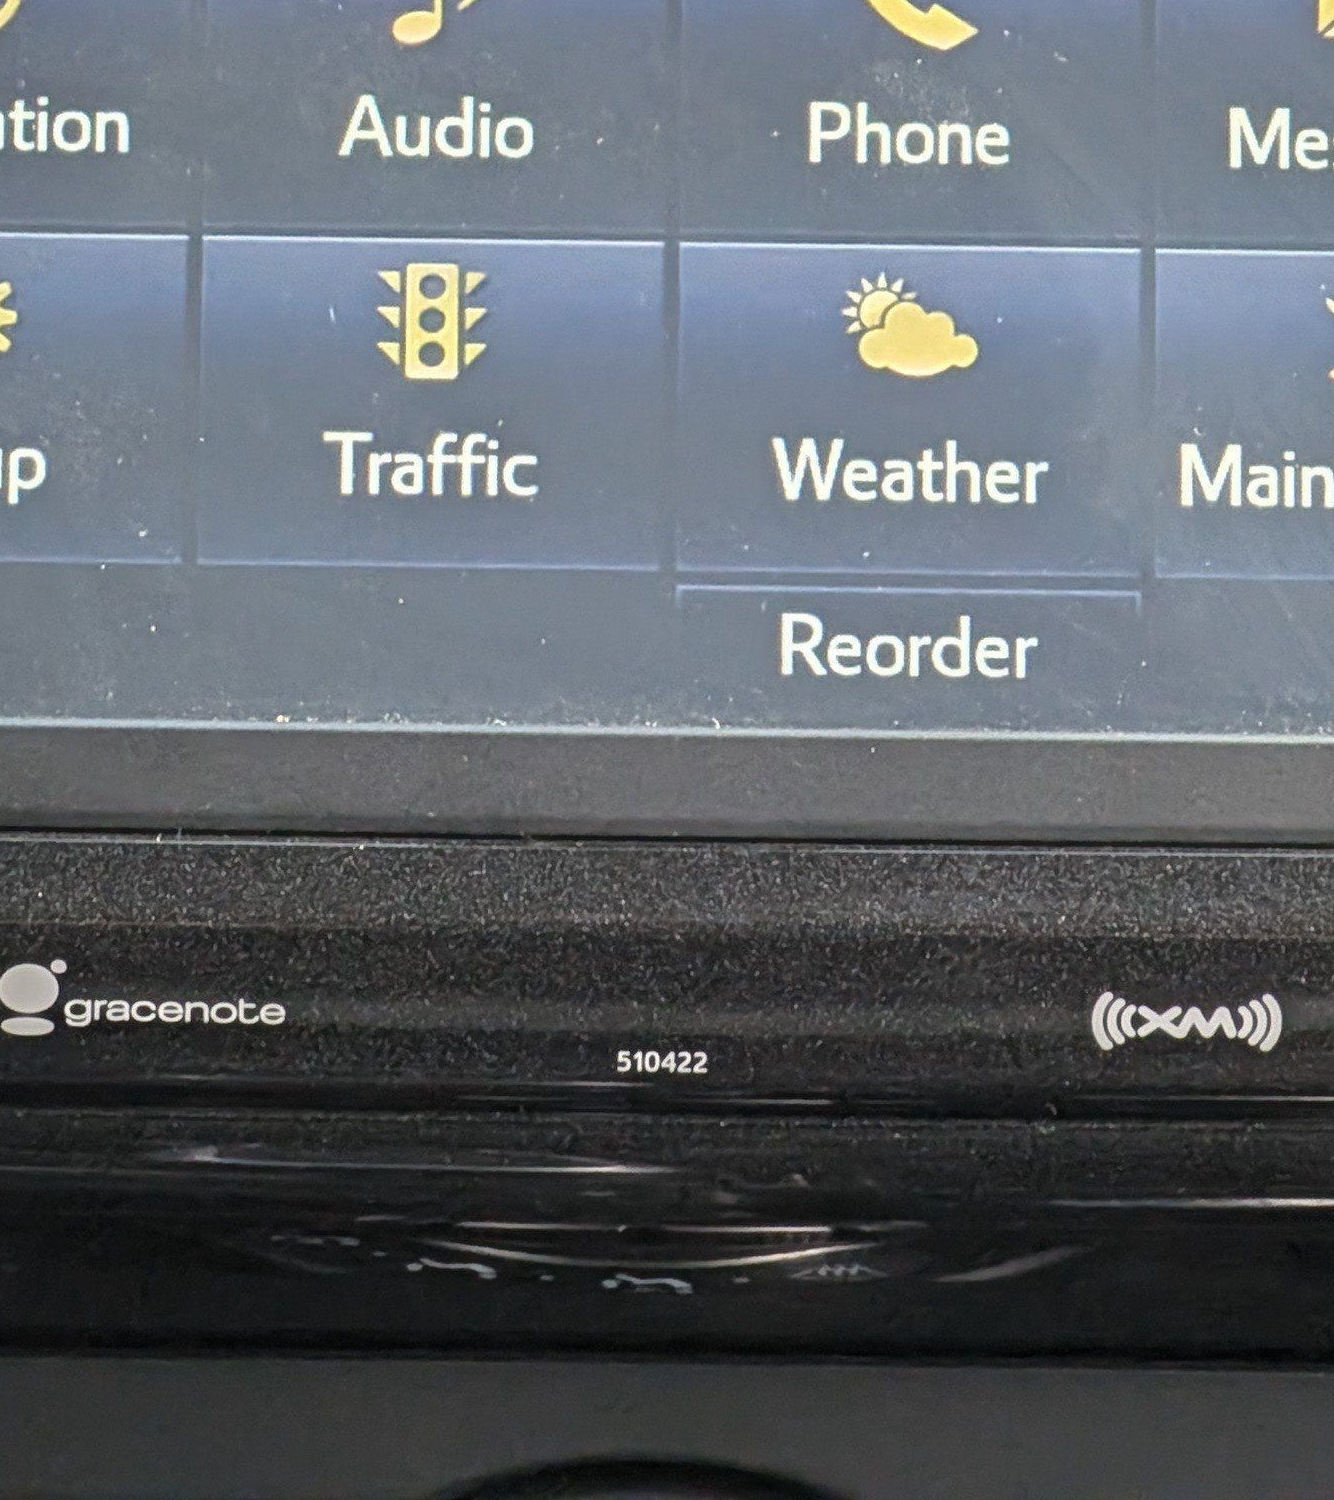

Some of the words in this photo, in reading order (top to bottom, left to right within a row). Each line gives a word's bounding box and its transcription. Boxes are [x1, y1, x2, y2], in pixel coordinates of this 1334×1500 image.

[338, 94, 534, 159] Audio
[808, 101, 1010, 166] Phone
[322, 431, 539, 497] Traffic
[772, 437, 1050, 504] Weather
[781, 612, 1039, 679] Reorder
[63, 997, 287, 1027] gracenote
[616, 1050, 708, 1074] 510422
